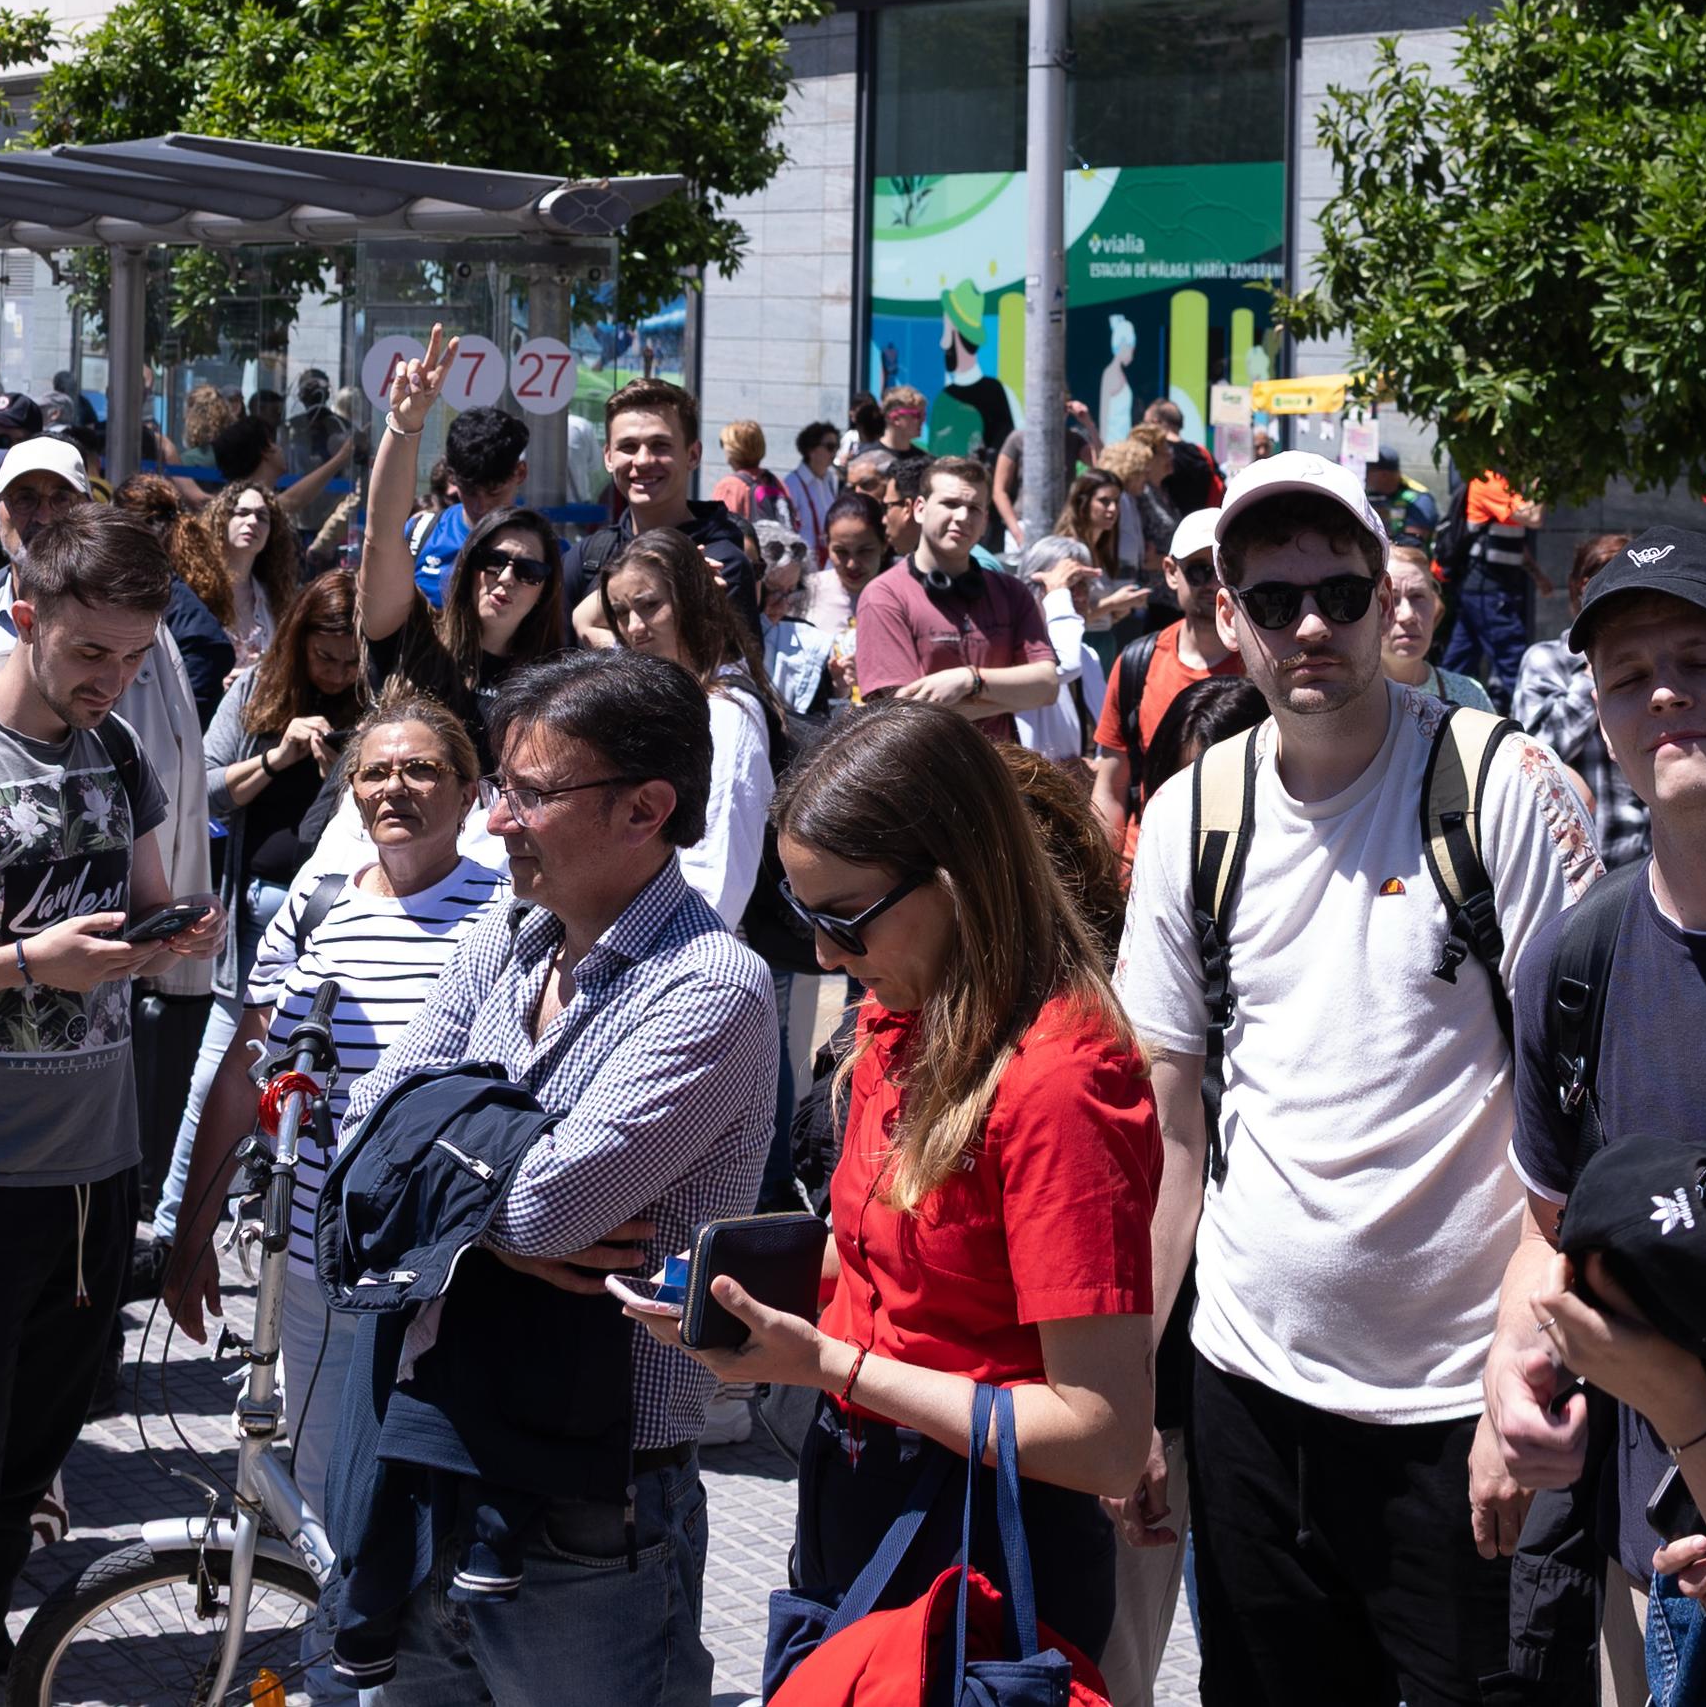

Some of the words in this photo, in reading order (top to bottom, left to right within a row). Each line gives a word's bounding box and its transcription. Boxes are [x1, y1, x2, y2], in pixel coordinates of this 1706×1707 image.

[1102, 233, 1146, 254] vialia
[1090, 260, 1132, 278] ESTACIÓN
[1134, 262, 1147, 278] DE
[1149, 259, 1191, 278] MÁLAGA
[1193, 259, 1227, 278] MARÍA
[460, 352, 486, 397] 7
[516, 352, 571, 397] 27
[9, 1058, 76, 1070] VENICE
